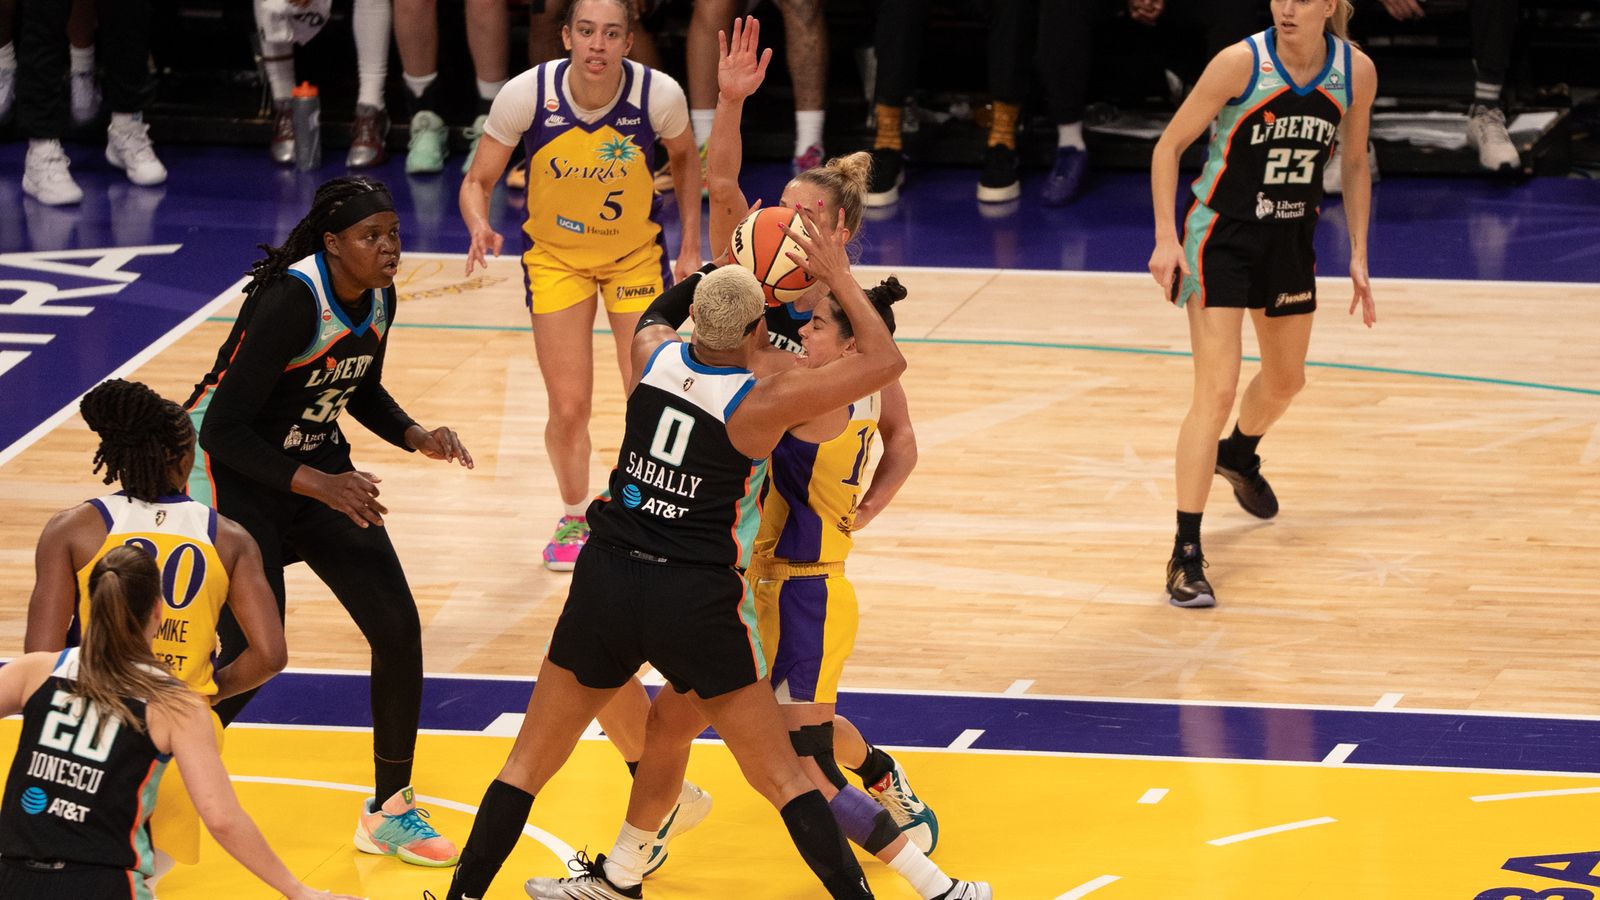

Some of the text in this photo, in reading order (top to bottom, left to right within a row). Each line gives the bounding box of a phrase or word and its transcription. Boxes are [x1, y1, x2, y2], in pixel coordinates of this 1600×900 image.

[615, 117, 641, 126] Albert
[1263, 148, 1320, 185] 23
[600, 190, 624, 221] 5
[1275, 208, 1305, 219] Mutual
[1277, 200, 1306, 210] Liberty
[559, 219, 620, 236] UCLA Health
[624, 286, 655, 297] WNBA
[650, 405, 695, 467] 0
[626, 451, 702, 498] SABALLY
[641, 497, 689, 518] AT&T
[38, 689, 121, 763] 20
[27, 751, 105, 794] IONESCU
[48, 797, 91, 822] AT&T
